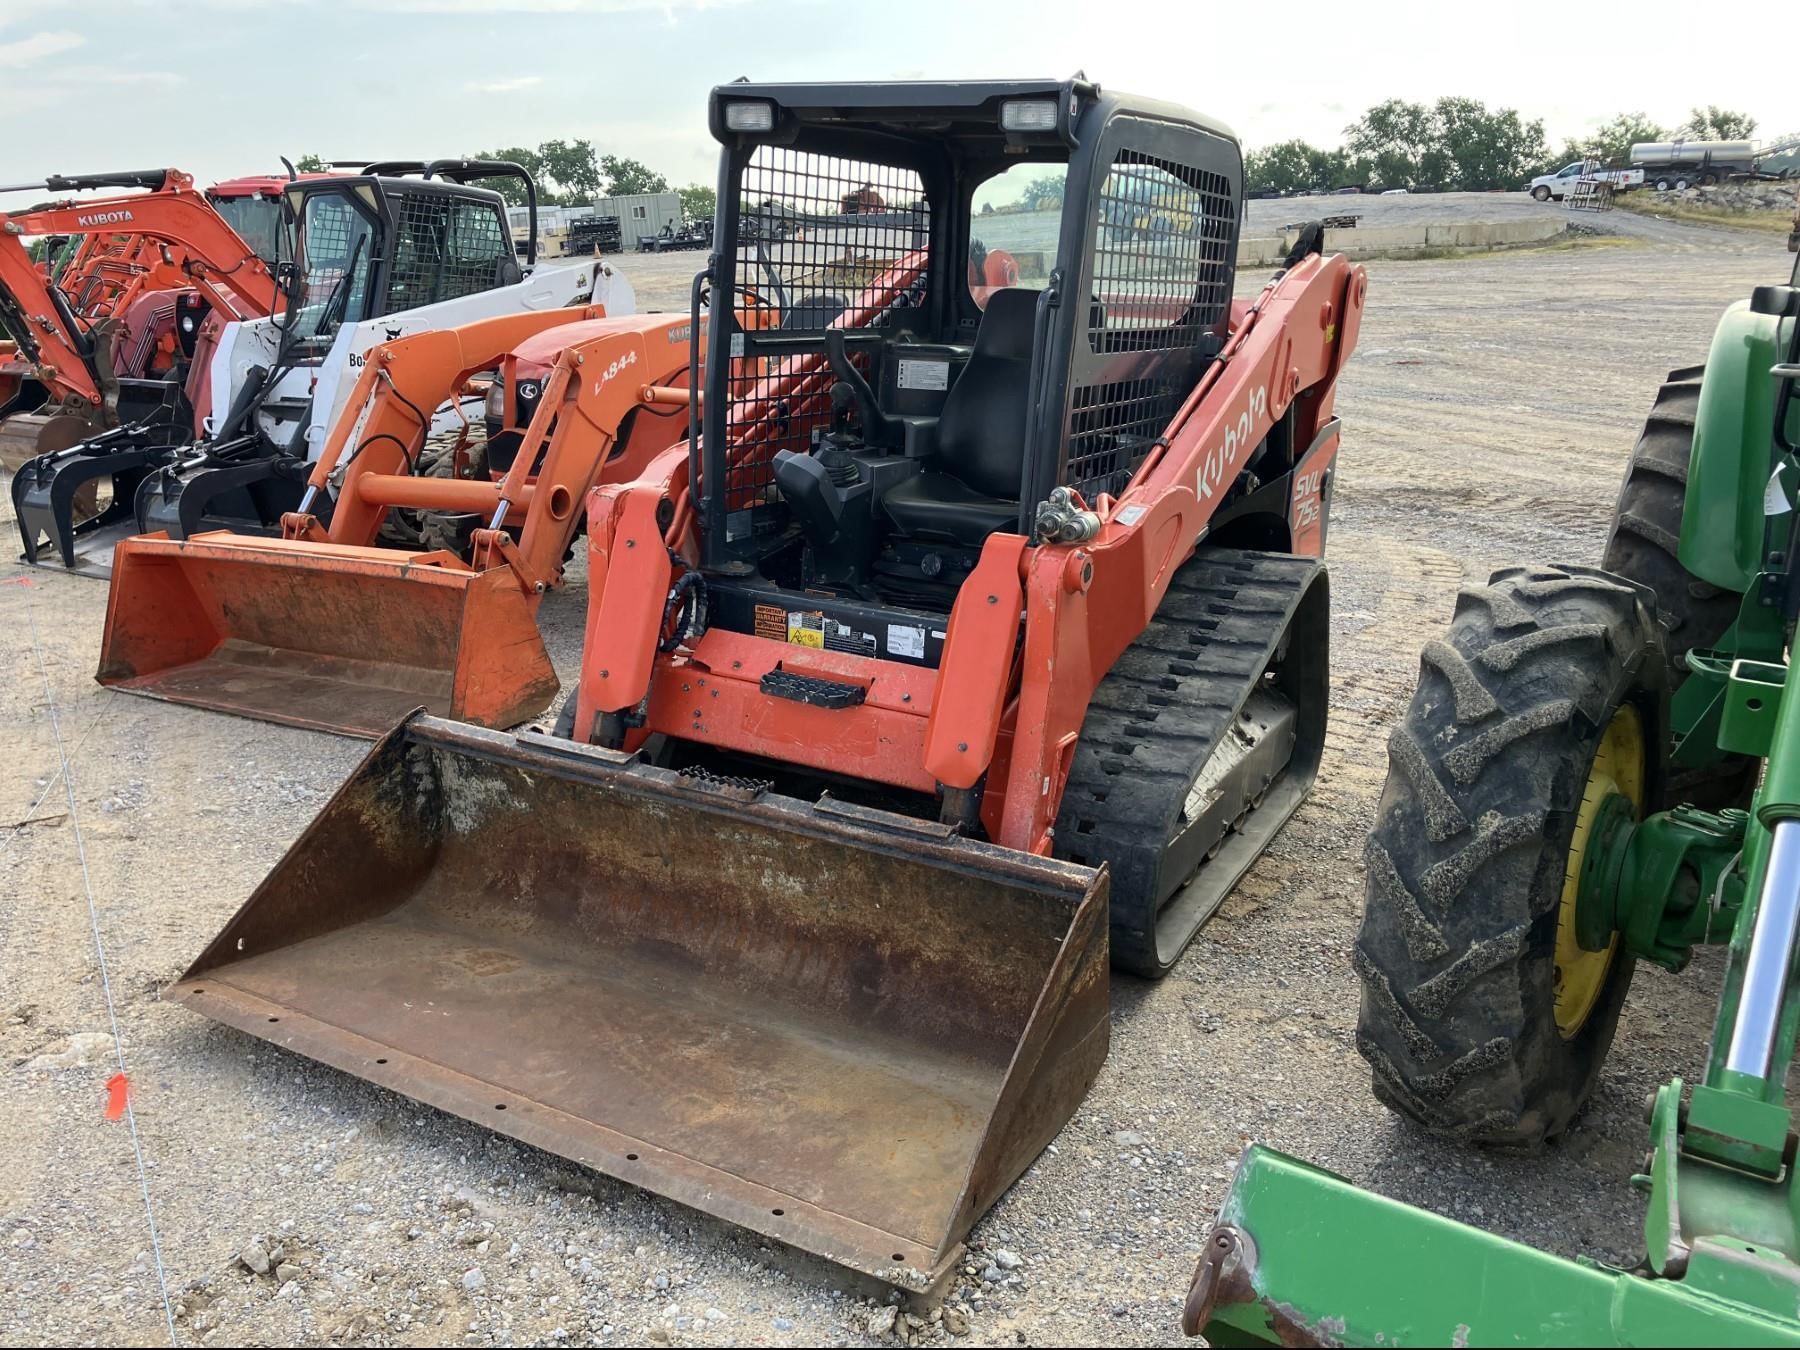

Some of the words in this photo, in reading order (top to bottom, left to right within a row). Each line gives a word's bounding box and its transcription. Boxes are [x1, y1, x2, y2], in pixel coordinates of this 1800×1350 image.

[78, 210, 133, 227] KUBOTA
[593, 351, 638, 396] LA844
[1196, 385, 1266, 503] Kubota
[1294, 470, 1320, 501] SVL
